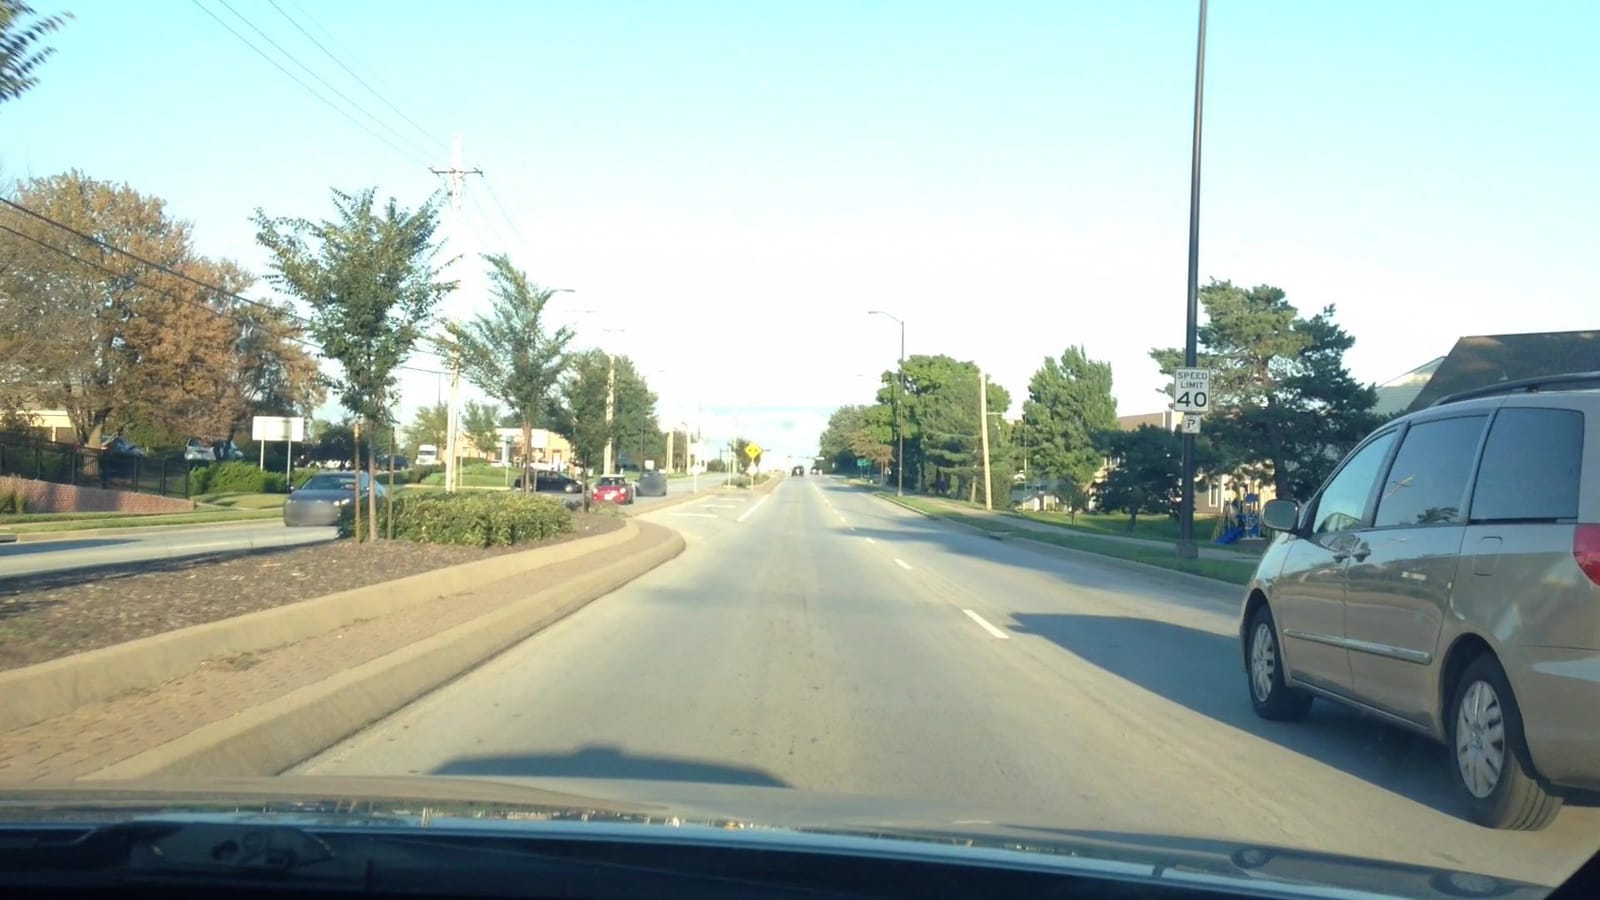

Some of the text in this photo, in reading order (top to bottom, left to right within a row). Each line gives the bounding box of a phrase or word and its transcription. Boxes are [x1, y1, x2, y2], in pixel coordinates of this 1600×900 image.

[1178, 372, 1208, 380] SPEED
[1181, 381, 1204, 389] LIMIT
[1177, 391, 1207, 408] 40
